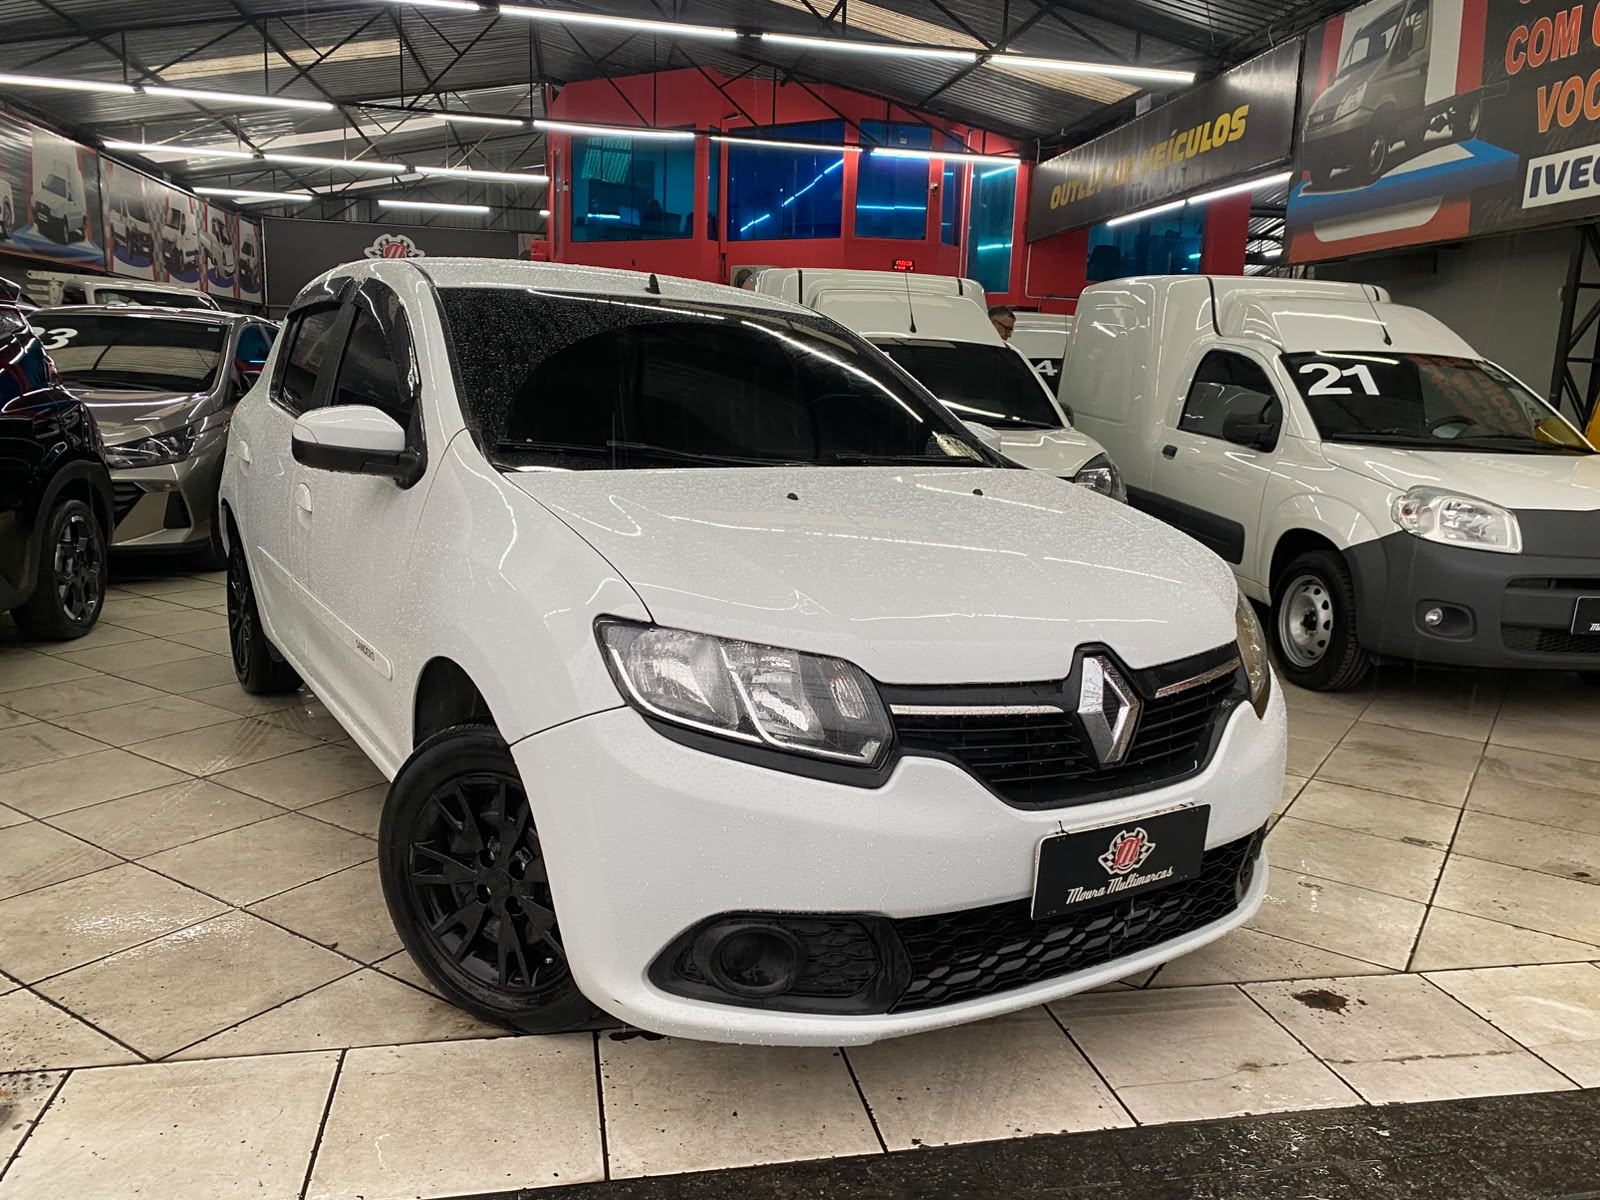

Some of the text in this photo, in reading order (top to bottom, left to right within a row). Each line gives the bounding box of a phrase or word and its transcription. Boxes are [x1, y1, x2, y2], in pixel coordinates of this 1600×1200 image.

[1505, 5, 1583, 75] COM
[1050, 168, 1107, 209] OUTLET
[1141, 104, 1249, 177] VEÍCULOS
[1299, 363, 1380, 395] 21
[1065, 866, 1174, 905] Moura Multimarcas
